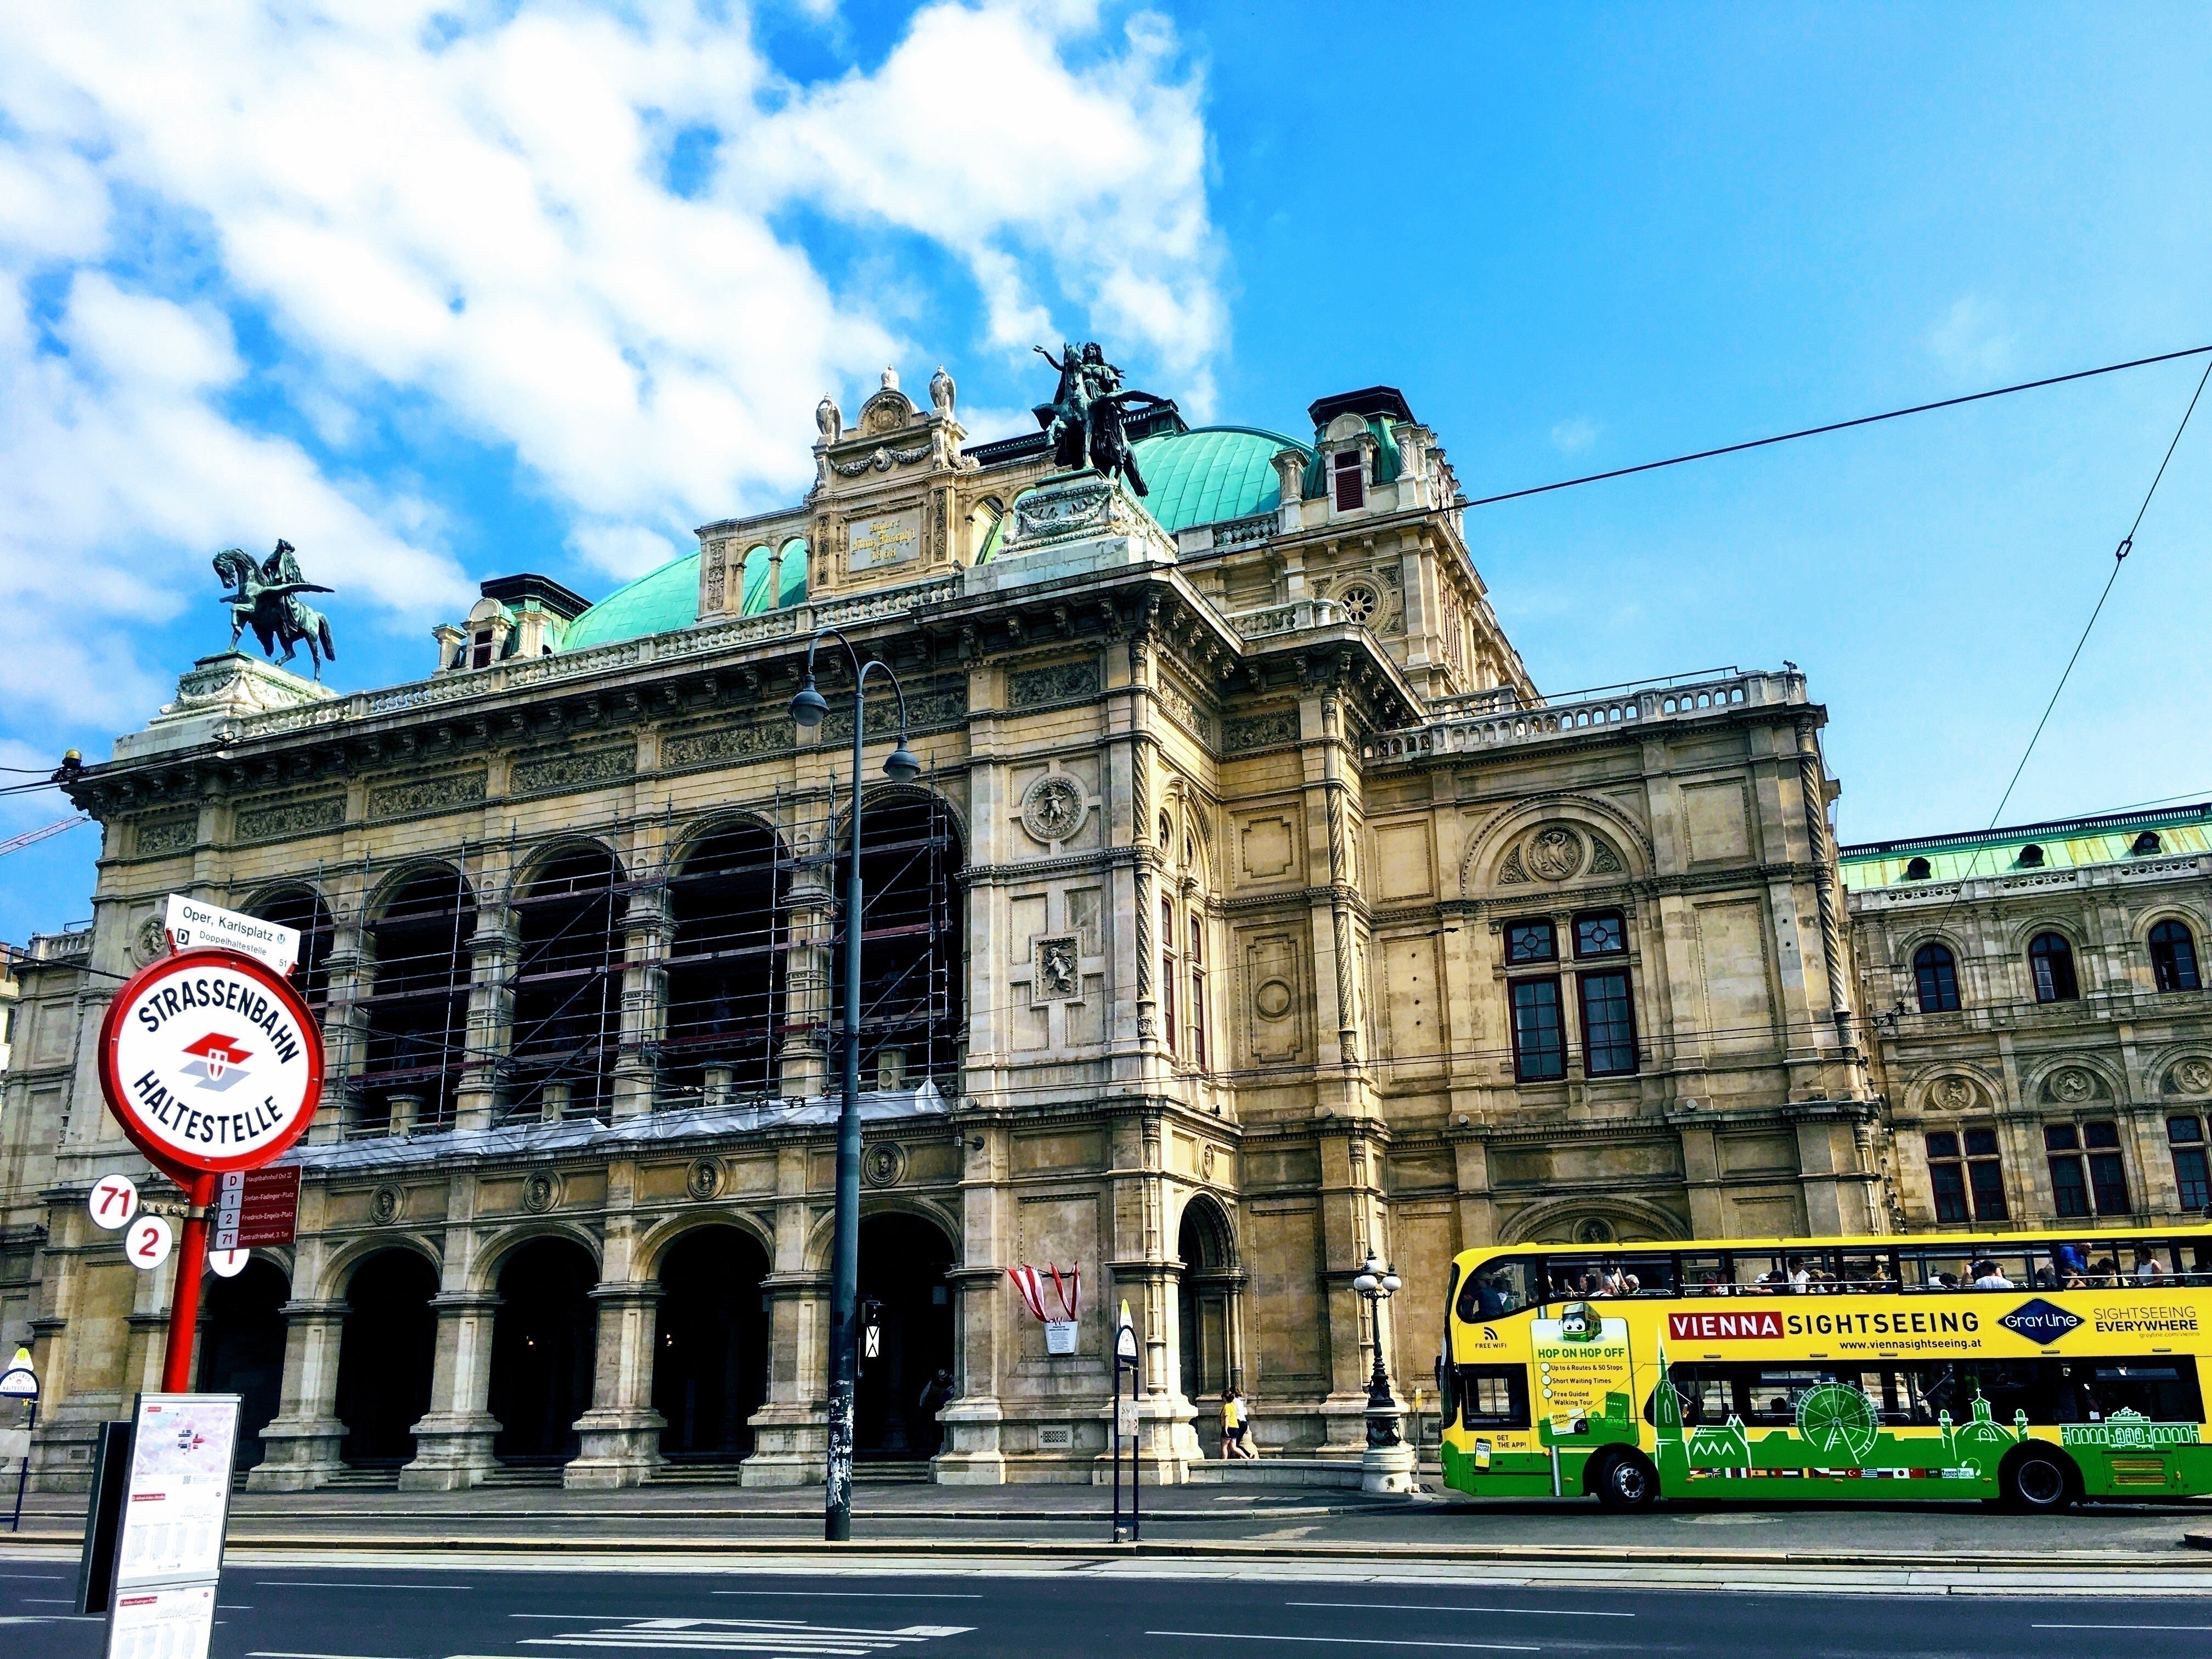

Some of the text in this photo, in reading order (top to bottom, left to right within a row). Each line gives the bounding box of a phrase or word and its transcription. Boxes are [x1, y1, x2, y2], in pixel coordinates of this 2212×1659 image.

[871, 548, 896, 562] 1868
[183, 906, 213, 926] Oper,
[219, 916, 273, 941] Karlsplatz
[200, 930, 267, 955] Doppelhaltestelle
[279, 959, 287, 967] 51
[138, 979, 300, 1064] STRASSENBAHN
[133, 1069, 283, 1144] HALTESTELLE
[229, 1176, 237, 1186] D
[246, 1173, 278, 1183] Hauptbahnhof
[100, 1186, 131, 1217] 71
[229, 1192, 294, 1205] 1 Stefan-Fadinger-Platz
[225, 1211, 294, 1224] 2 Friedrich-Engels-Platz
[139, 1228, 159, 1257] 2
[222, 1234, 233, 1245] 71
[239, 1232, 275, 1241] Zentralfriedhof,
[2094, 1306, 2196, 1320] SIGHTSEEING
[1673, 1312, 1979, 1336] VIENNA SIGHTSEEING
[2005, 1314, 2042, 1328] Gray
[2095, 1319, 2198, 1332] EVERYWHERE
[1839, 1339, 1982, 1350] www.viennasightseeing.at
[1538, 1347, 1625, 1358] HOP ON HOP OFF
[9, 1373, 31, 1382] AUTOBUS
